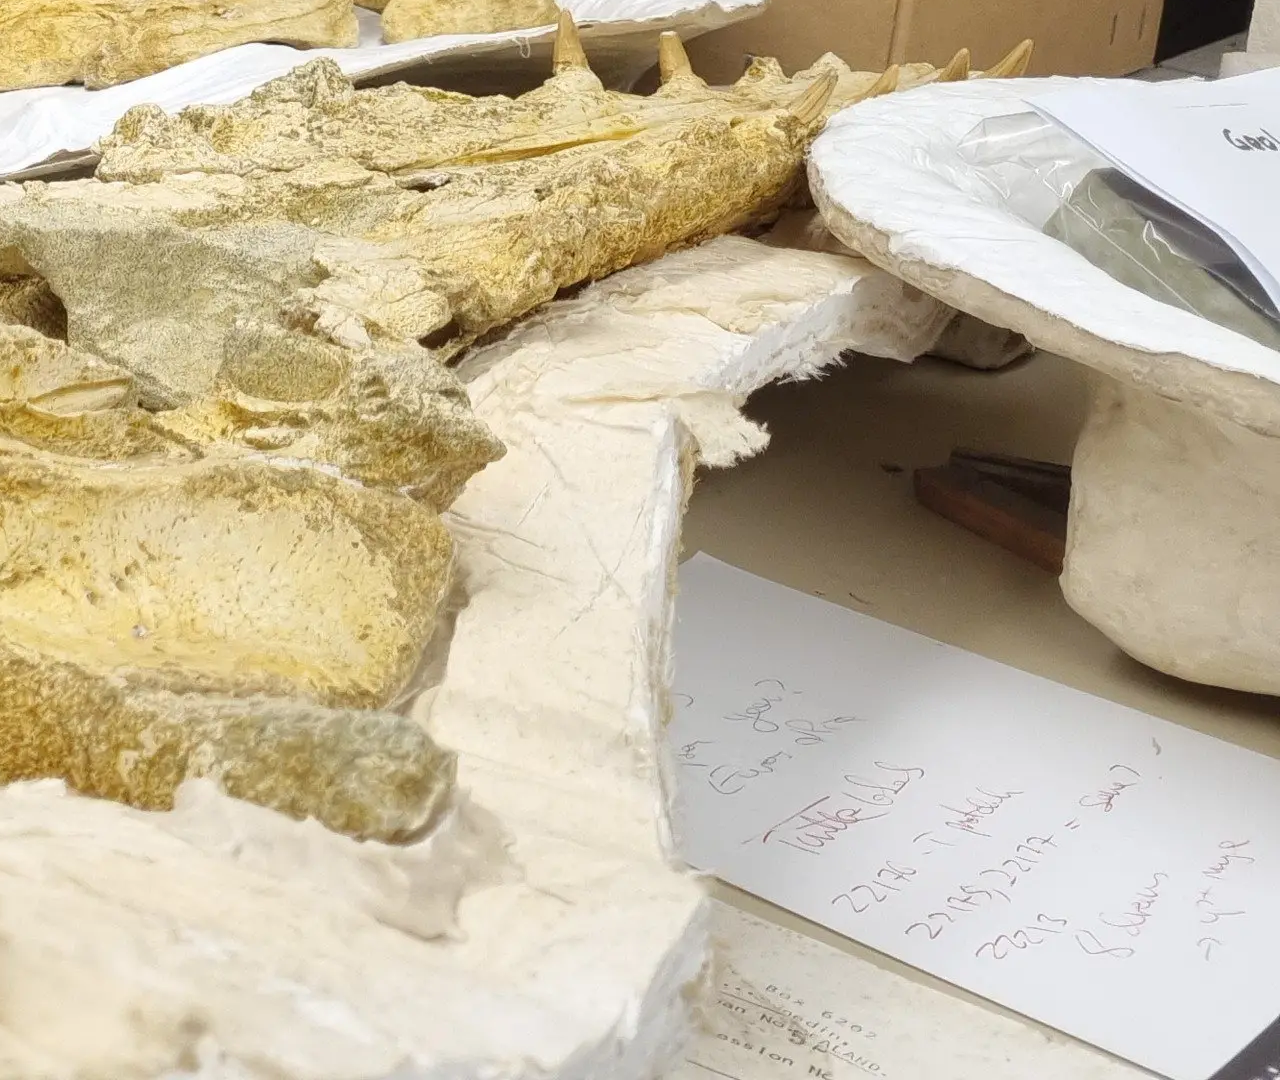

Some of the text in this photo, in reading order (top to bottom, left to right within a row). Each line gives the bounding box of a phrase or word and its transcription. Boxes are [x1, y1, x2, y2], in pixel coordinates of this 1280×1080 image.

[765, 984, 878, 1039] Box 6202
[779, 1006, 850, 1046] nedin.
[715, 1032, 795, 1067] ession
